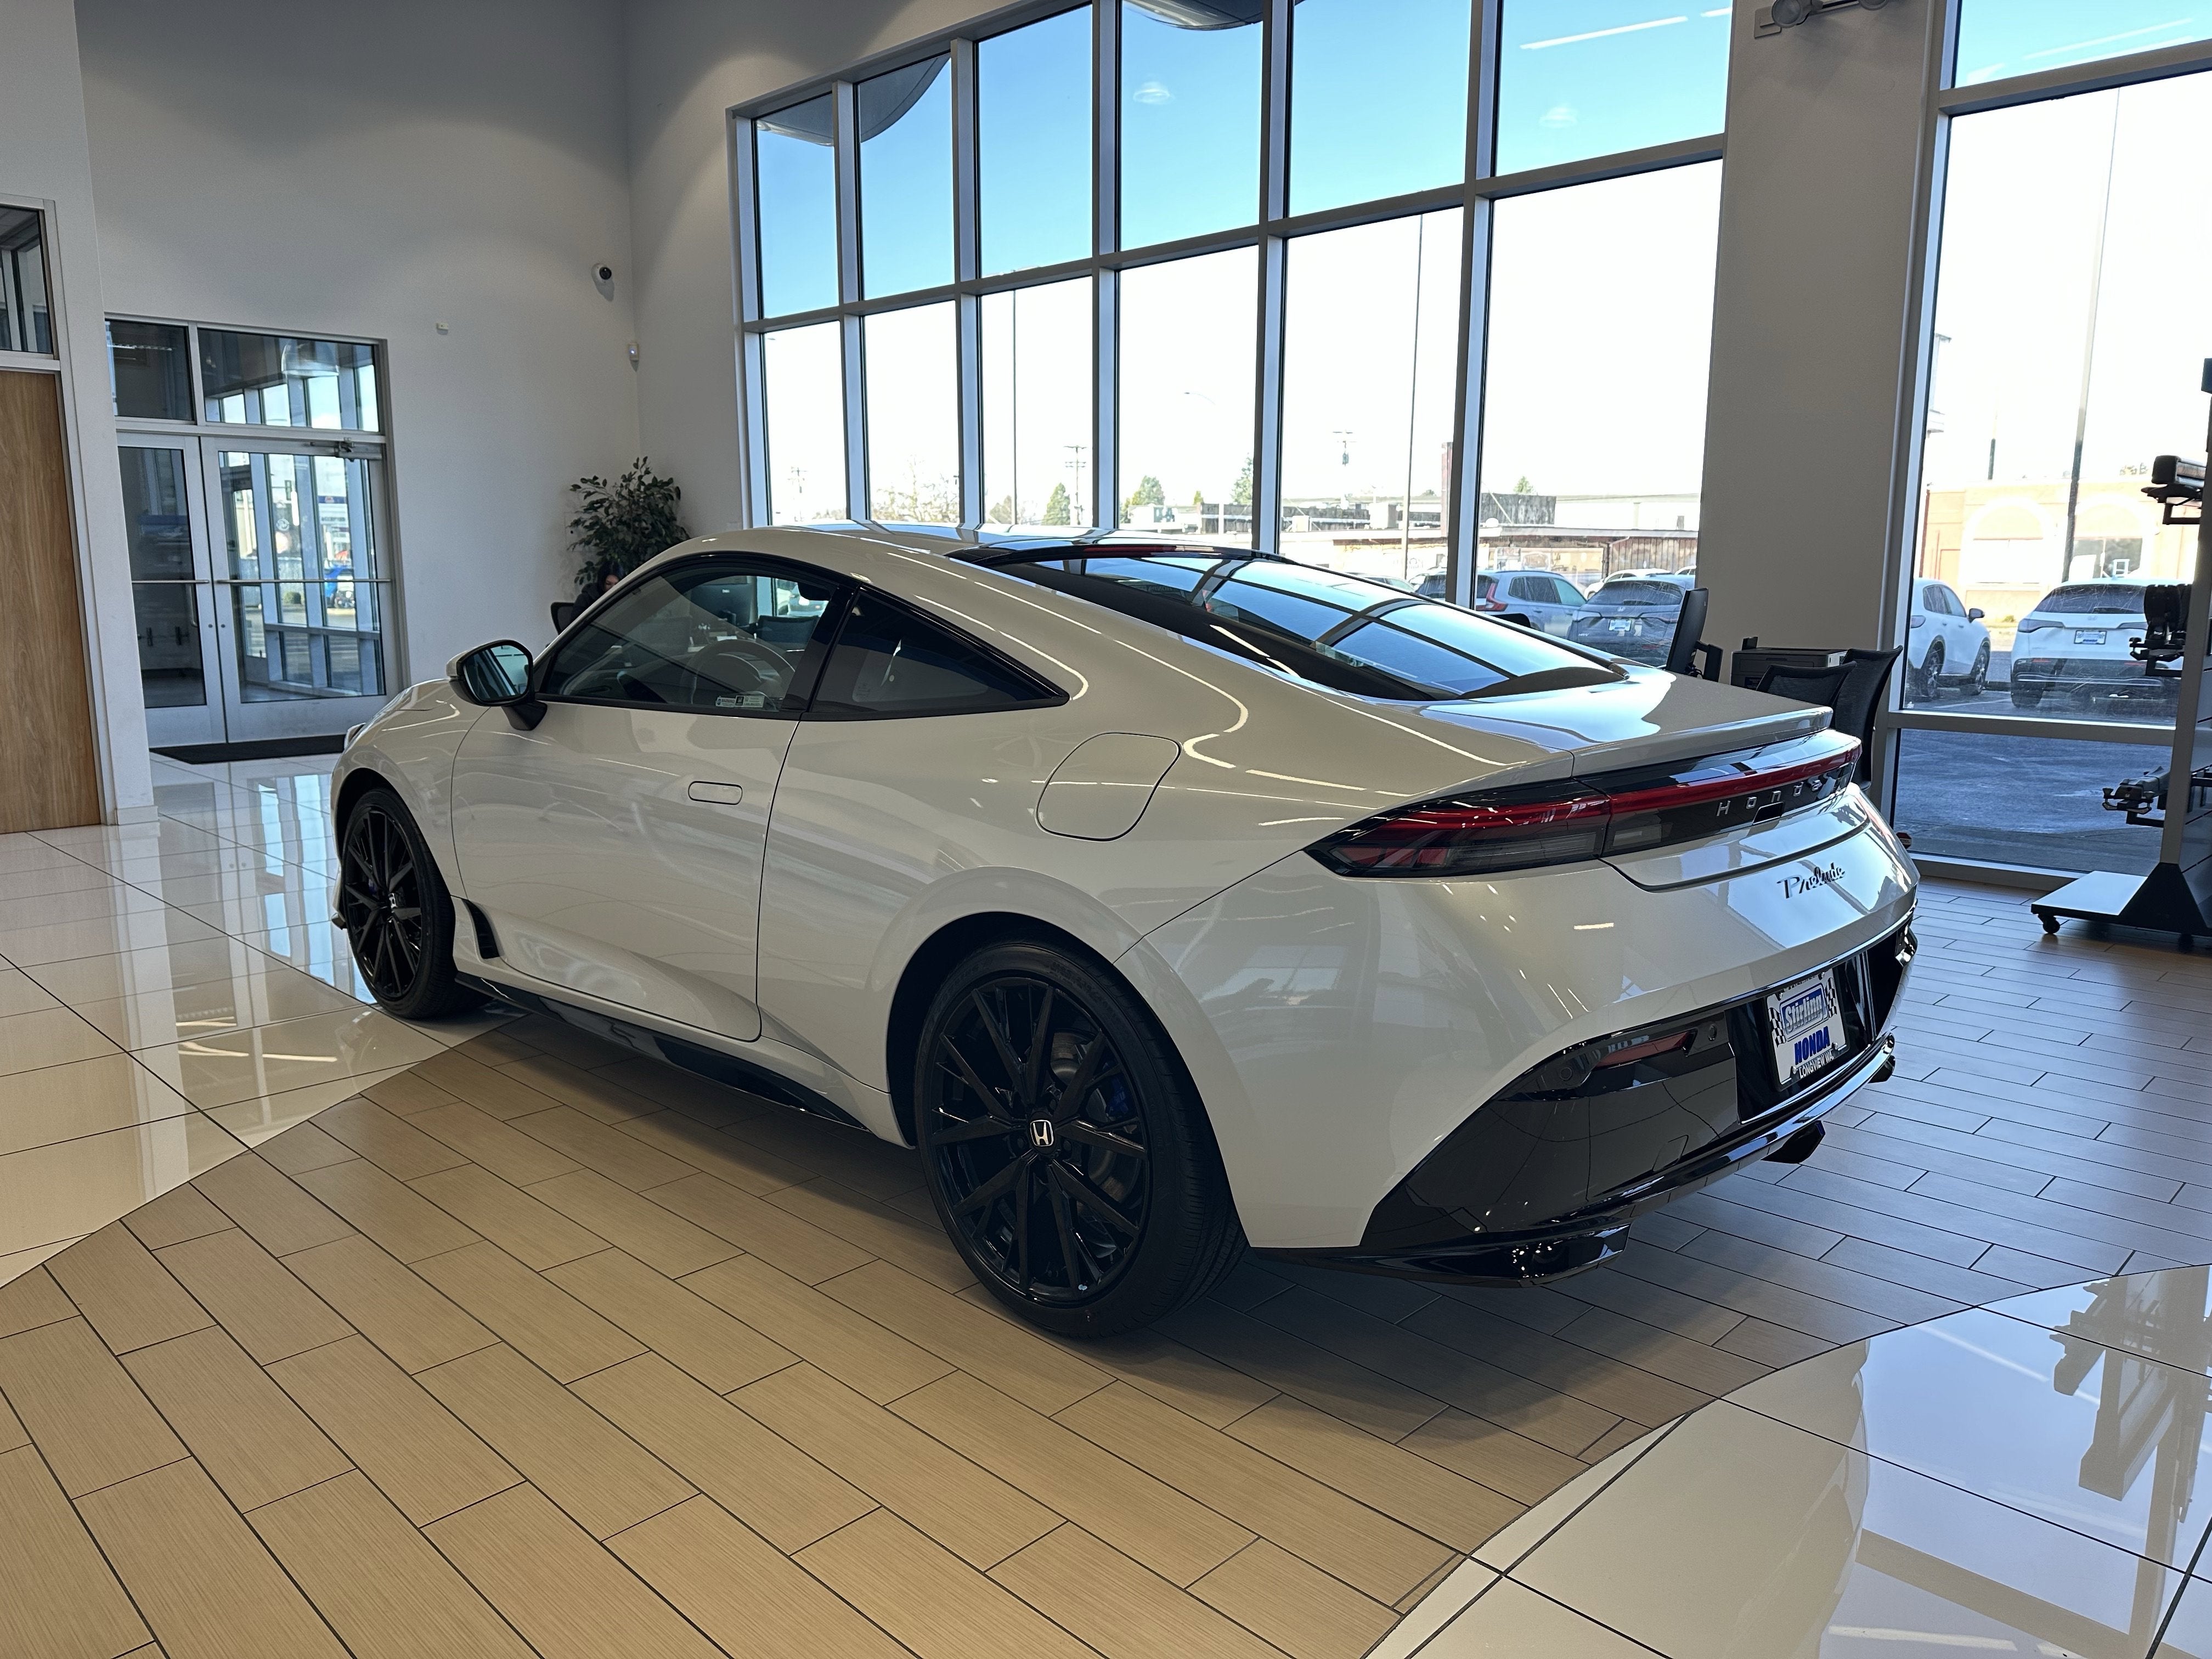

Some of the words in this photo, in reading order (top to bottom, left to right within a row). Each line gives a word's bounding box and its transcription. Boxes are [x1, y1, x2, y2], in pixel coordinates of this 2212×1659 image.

[1776, 862, 1846, 899] Prelude
[1784, 994, 1824, 1035] Stirling
[1794, 1025, 1830, 1065] HONDA
[1798, 1053, 1825, 1079] LONGVIEW
